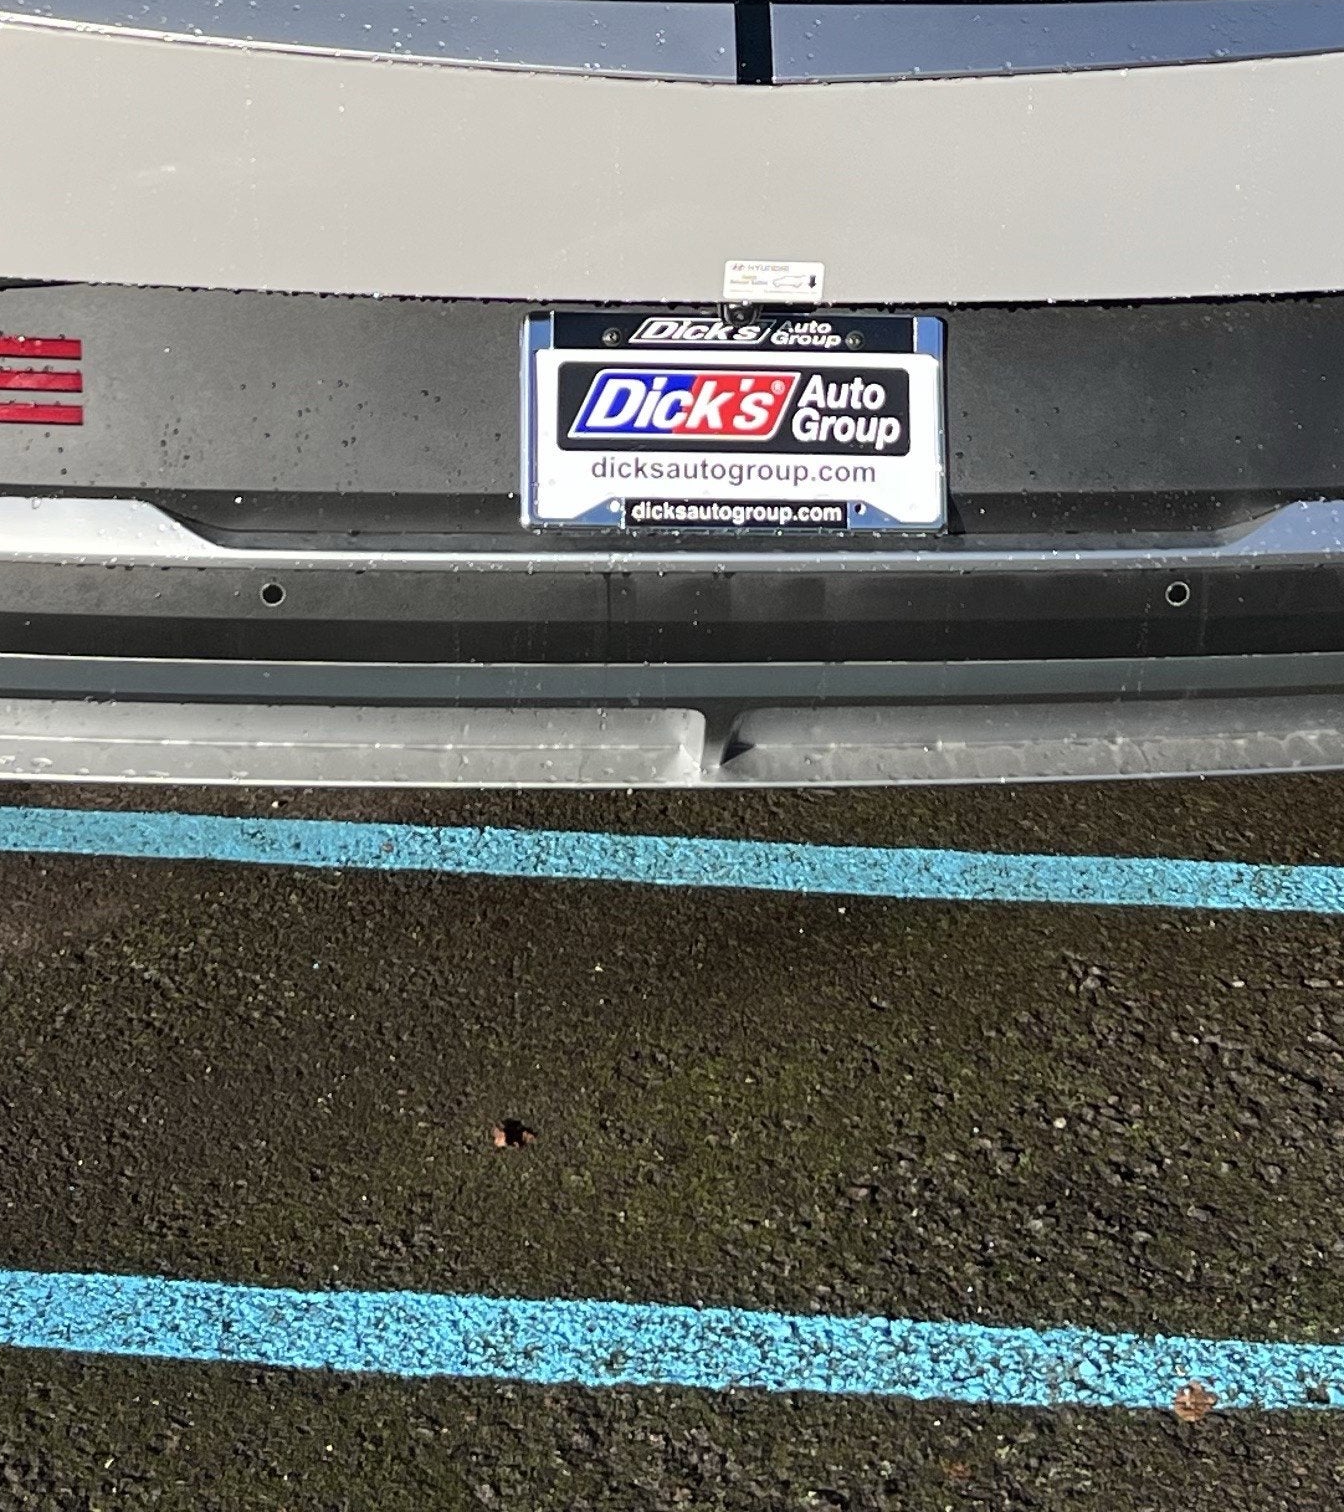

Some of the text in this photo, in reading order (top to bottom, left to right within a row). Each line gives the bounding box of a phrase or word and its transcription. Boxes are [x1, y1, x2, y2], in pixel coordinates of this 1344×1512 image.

[640, 320, 761, 341] Dicks
[770, 331, 842, 348] Group
[776, 319, 833, 335] Auto
[584, 376, 776, 431] Dick's
[797, 374, 886, 410] Auto
[791, 406, 902, 451] Group
[590, 456, 877, 487] dicksautogroup.com
[630, 501, 843, 525] dicksautogroup.com
